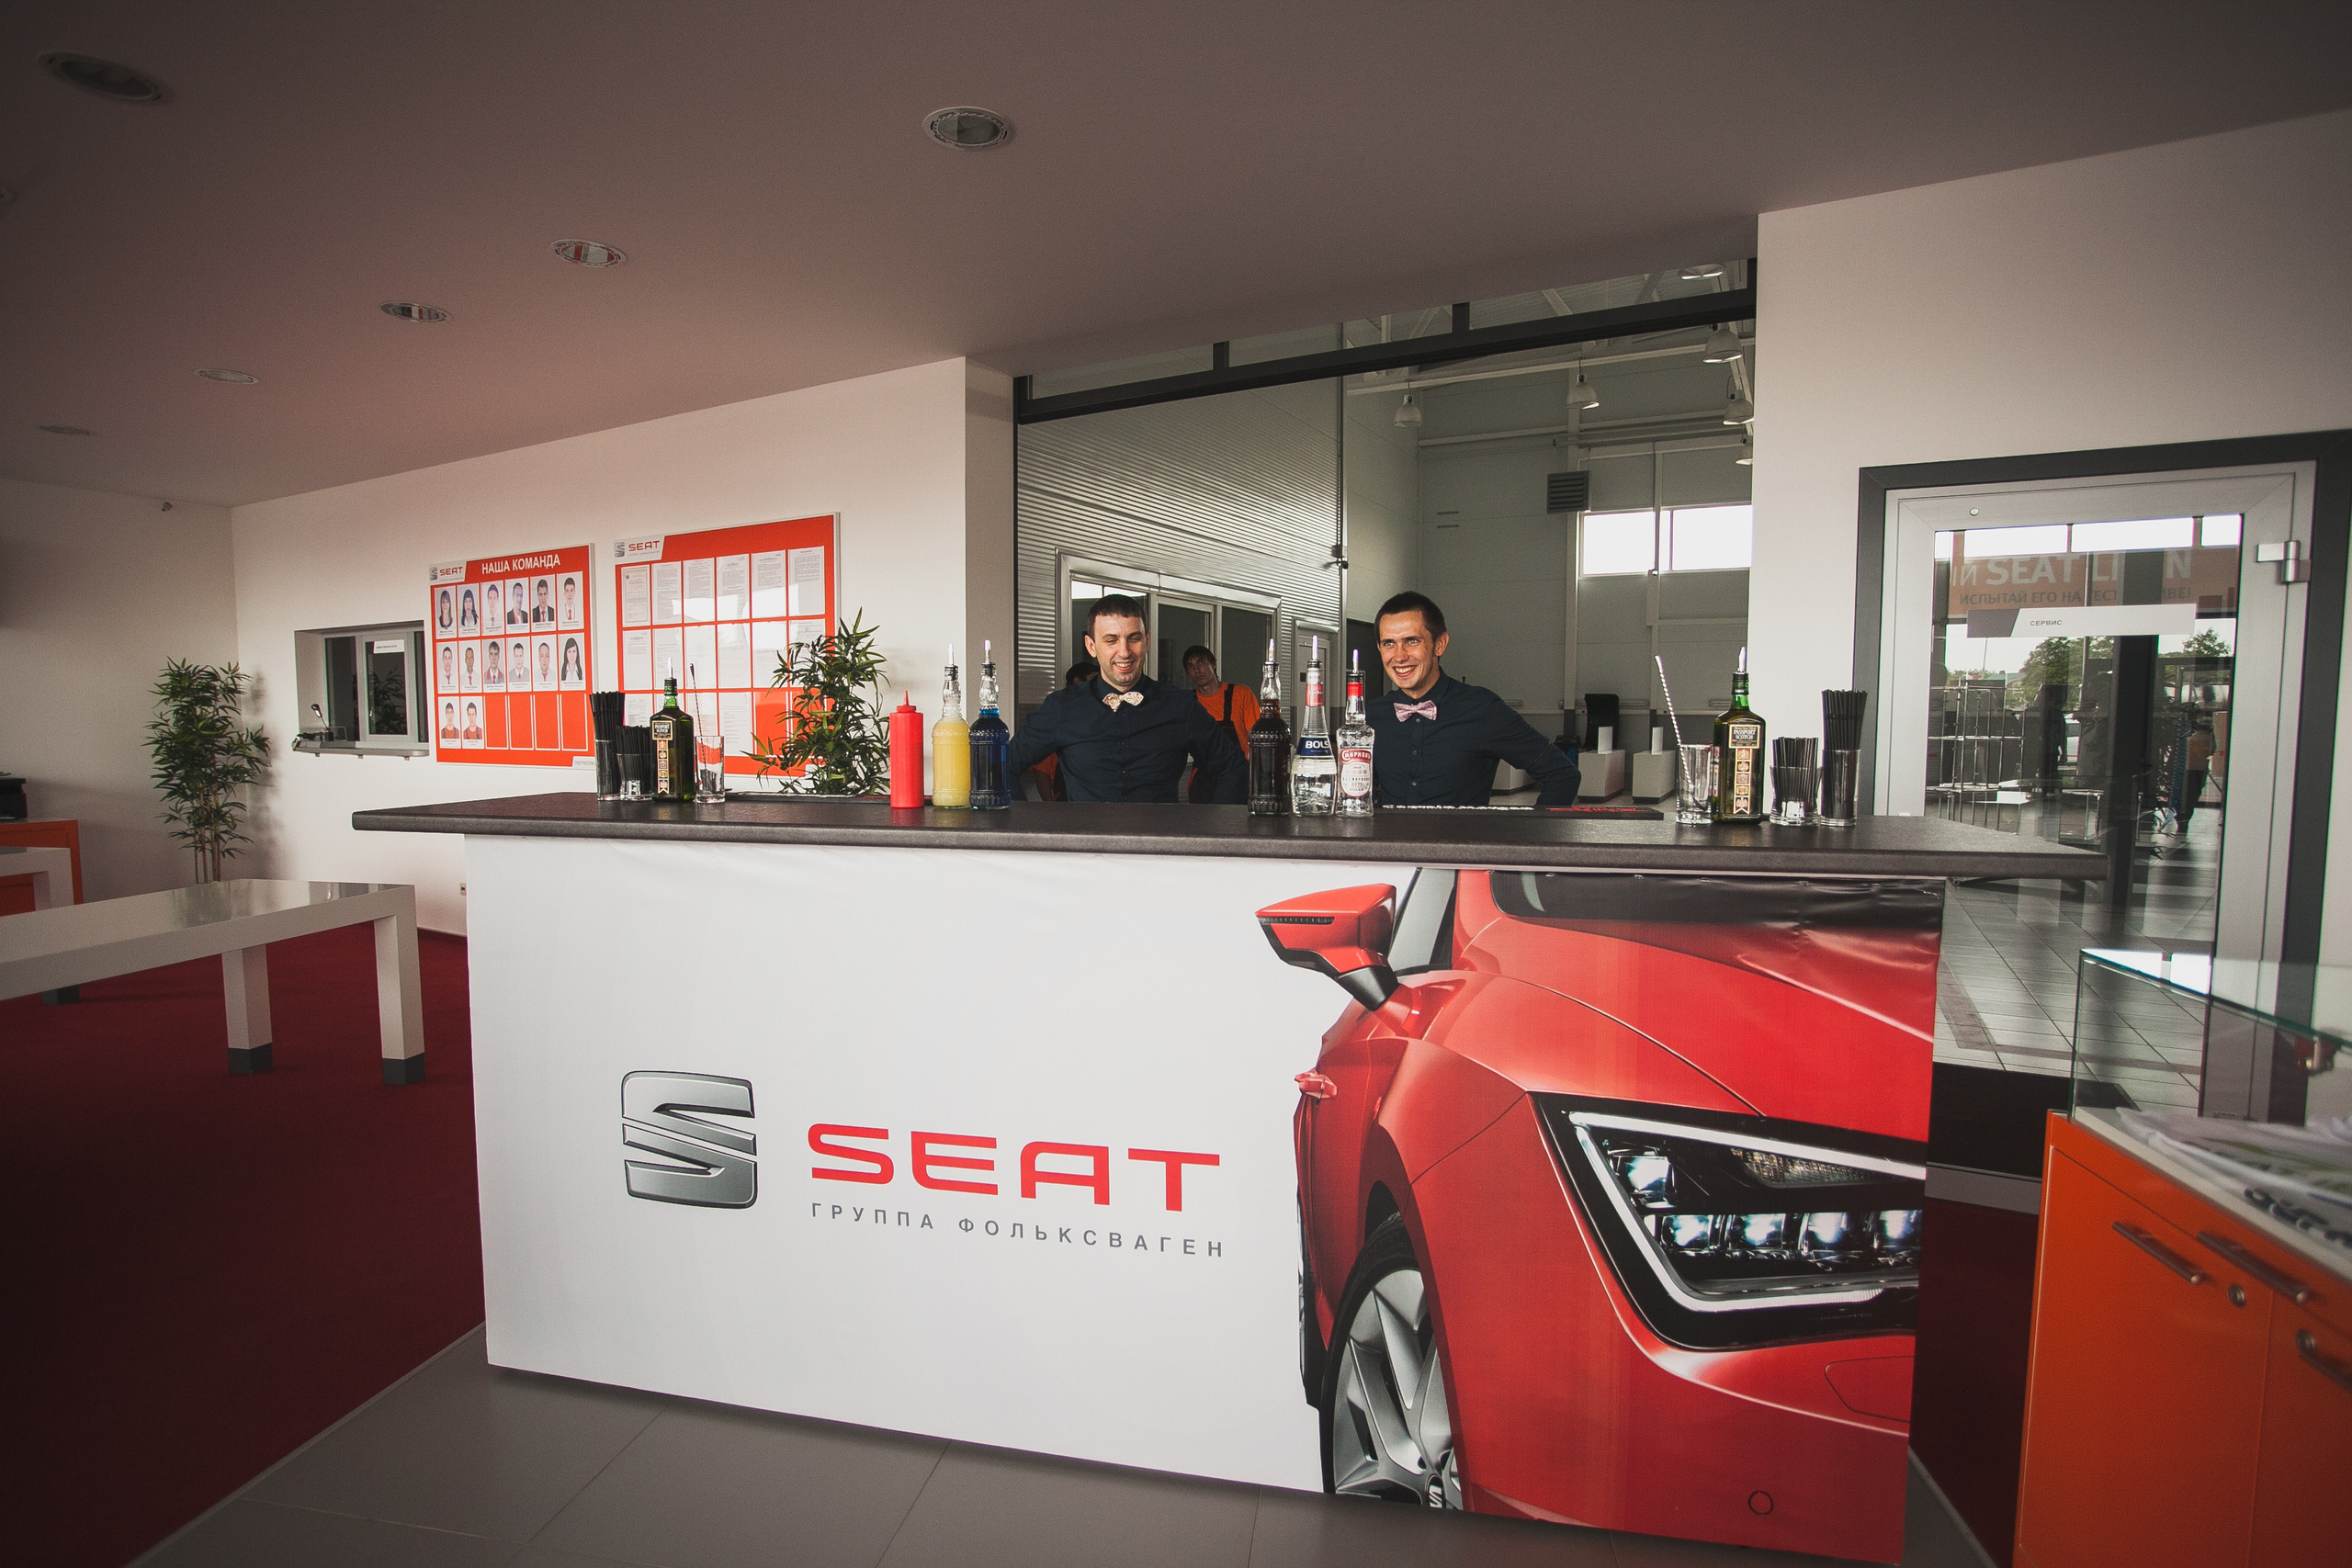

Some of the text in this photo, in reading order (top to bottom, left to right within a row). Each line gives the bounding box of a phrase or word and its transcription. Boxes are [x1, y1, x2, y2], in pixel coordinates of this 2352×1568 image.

[628, 540, 660, 551] SEAT
[439, 566, 464, 576] SEAT
[481, 554, 560, 575] НАША КОМАНДА
[1985, 554, 2081, 585] SEAT
[2092, 549, 2192, 581] LN
[1960, 591, 2028, 605] ИСПЫТАЙ
[2031, 592, 2057, 604] ЕГО
[2062, 591, 2082, 603] НА
[1305, 740, 1329, 749] BOLS
[808, 1123, 1220, 1212] SEAT
[811, 1202, 1222, 1258] ГРУППА ФОЛЬКСВАГЕН
